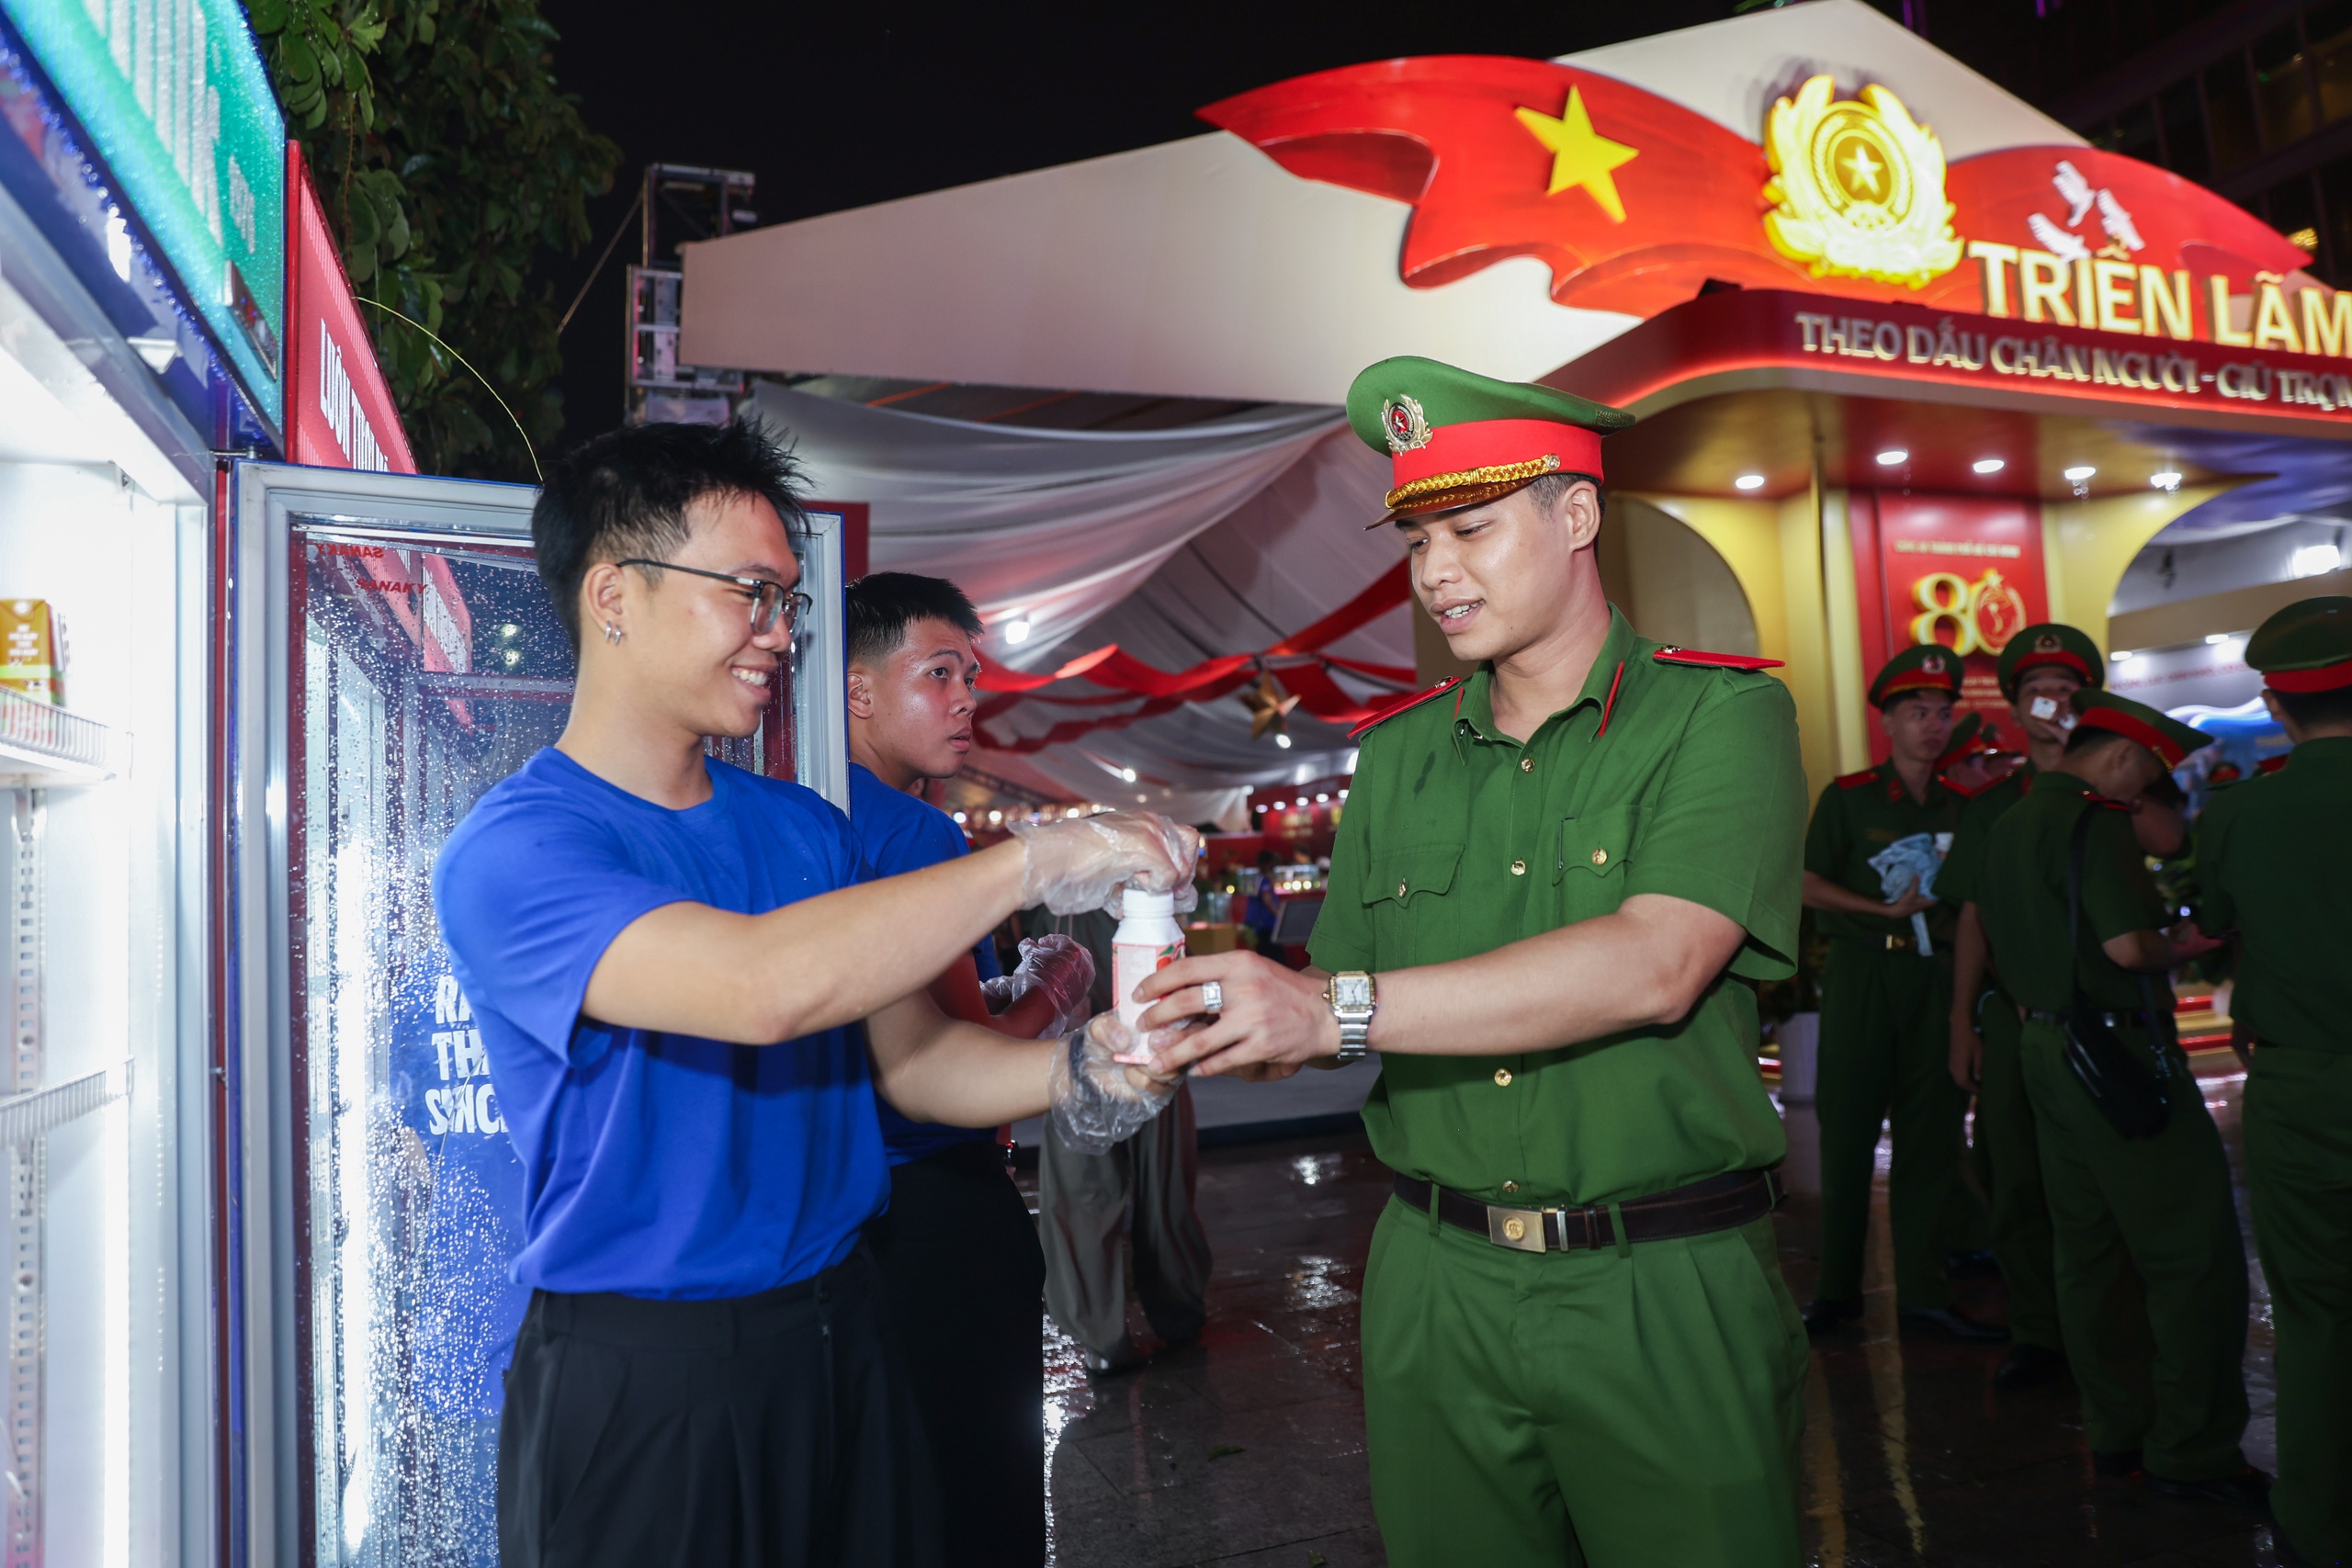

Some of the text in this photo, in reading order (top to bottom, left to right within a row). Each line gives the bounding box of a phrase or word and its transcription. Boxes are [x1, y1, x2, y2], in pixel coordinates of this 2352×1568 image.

[1968, 233, 2352, 359] TRIỂN LÃM
[1795, 311, 1904, 361] THEO
[1905, 315, 1987, 371] DẤU
[1989, 334, 2091, 381] CHÂN
[320, 317, 351, 462] LUÔN
[431, 1028, 491, 1081] TH
[424, 1083, 510, 1135] SINC
